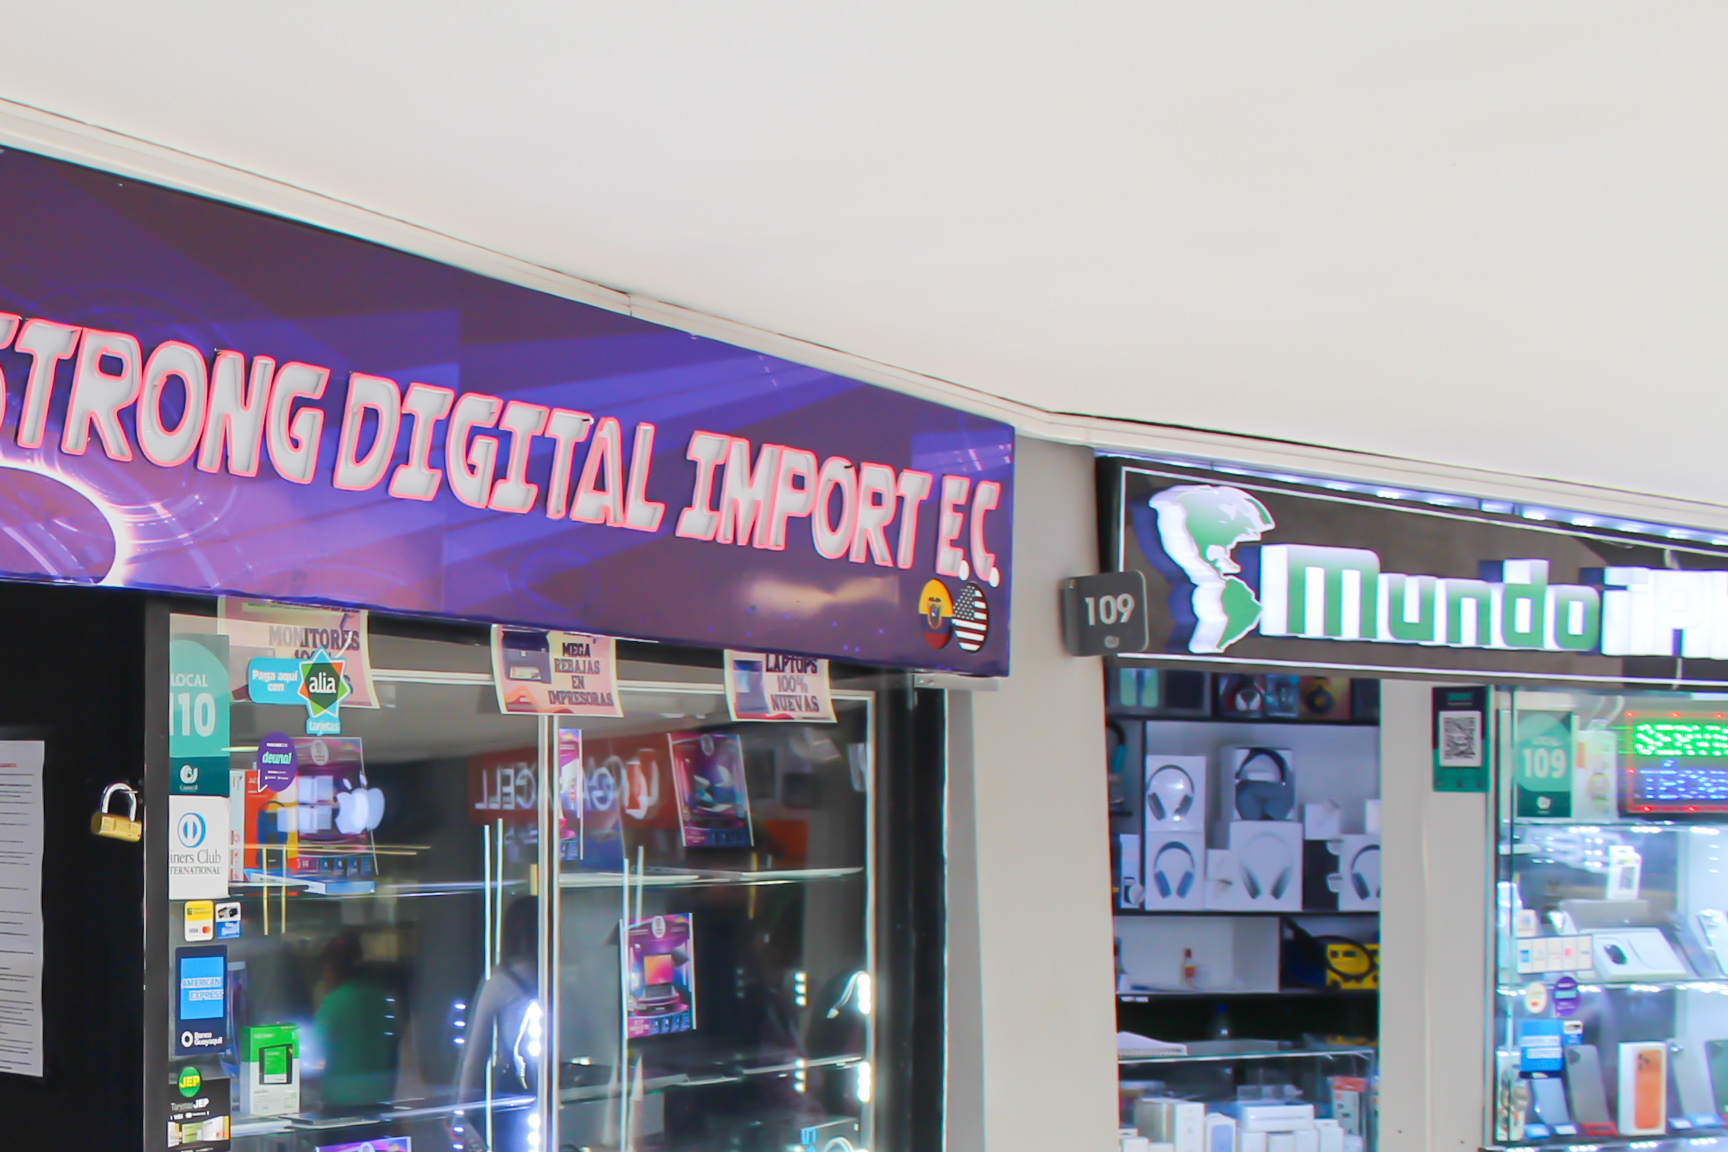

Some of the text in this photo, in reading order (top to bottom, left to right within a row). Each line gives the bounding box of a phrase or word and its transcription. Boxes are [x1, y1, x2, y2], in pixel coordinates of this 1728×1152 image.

[332, 371, 665, 533] DIGITAL
[675, 430, 933, 570] IMPORT
[1258, 543, 1601, 652] Mundo
[1084, 593, 1136, 626] 109
[269, 626, 361, 651] MONITORES
[562, 642, 591, 658] MEGA
[554, 658, 601, 675] REBAJAS
[765, 653, 819, 674] LAPTOPS
[170, 672, 209, 687] LOCAL
[252, 669, 276, 683] Paga
[309, 671, 337, 694] alia
[571, 675, 585, 690] EN
[776, 674, 809, 693] 100%
[267, 683, 285, 692] con
[548, 690, 614, 707] IMPRESORAS
[771, 694, 820, 713] NUEVAS
[1522, 748, 1567, 779] 109
[170, 849, 222, 865] iners Club
[170, 866, 222, 876] TERNATIONAL
[181, 978, 222, 988] AMERICAN
[190, 990, 224, 1000] EXPRESS
[179, 1075, 201, 1089] JEP
